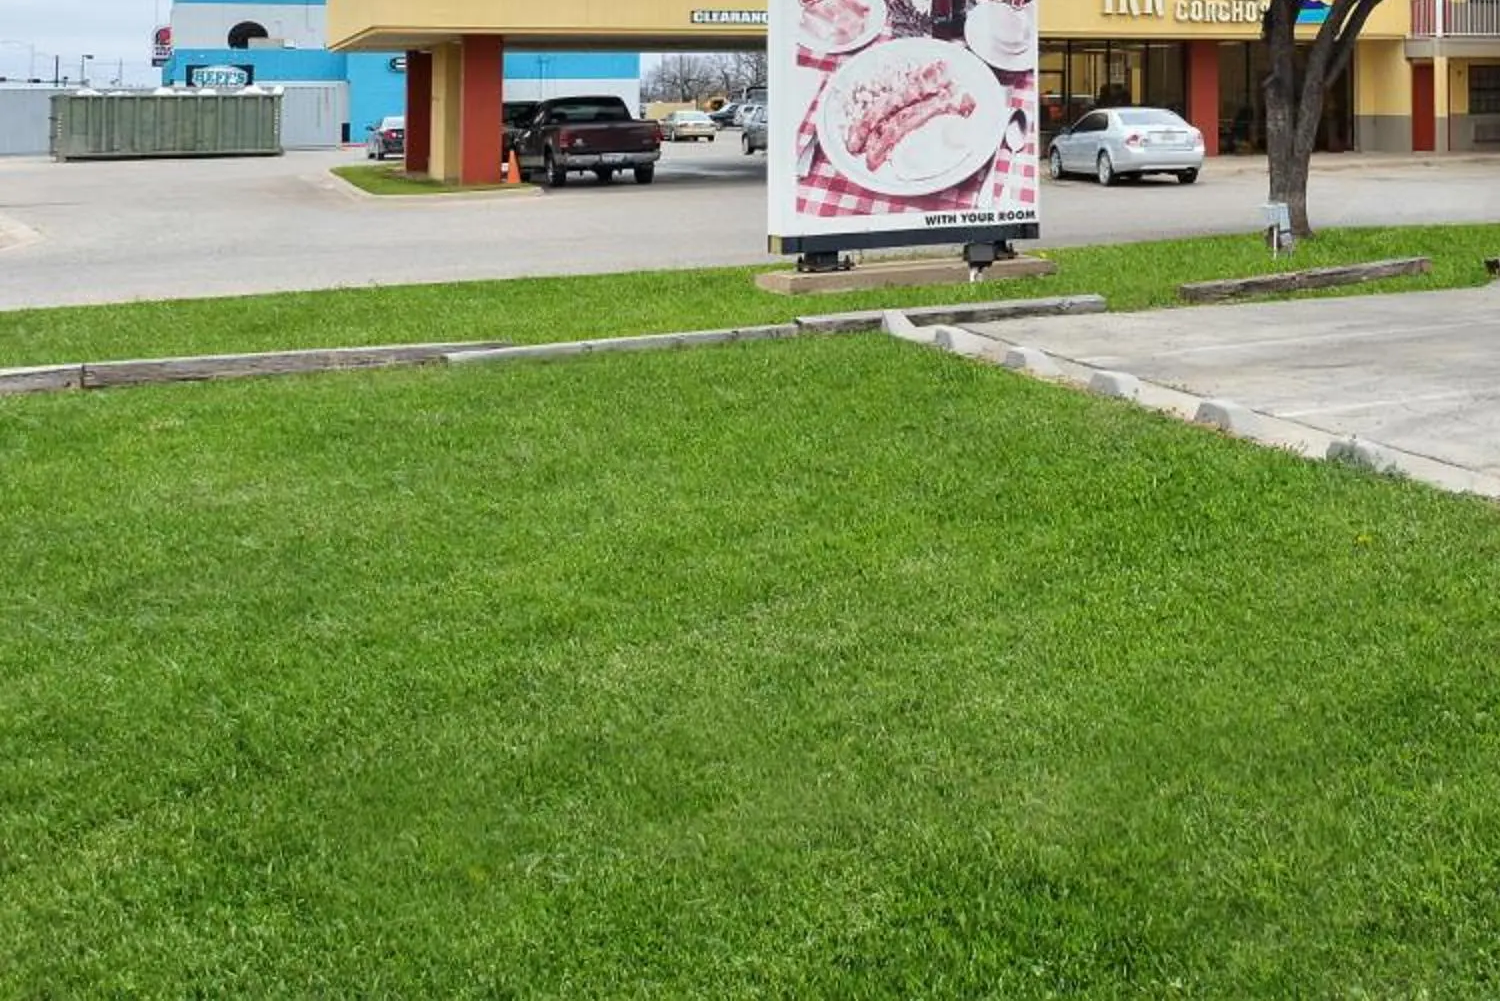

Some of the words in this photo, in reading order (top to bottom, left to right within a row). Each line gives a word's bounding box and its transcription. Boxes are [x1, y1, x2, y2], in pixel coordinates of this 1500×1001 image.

[925, 213, 957, 226] WITH
[960, 211, 995, 223] YOUR
[998, 209, 1036, 221] ROOM
